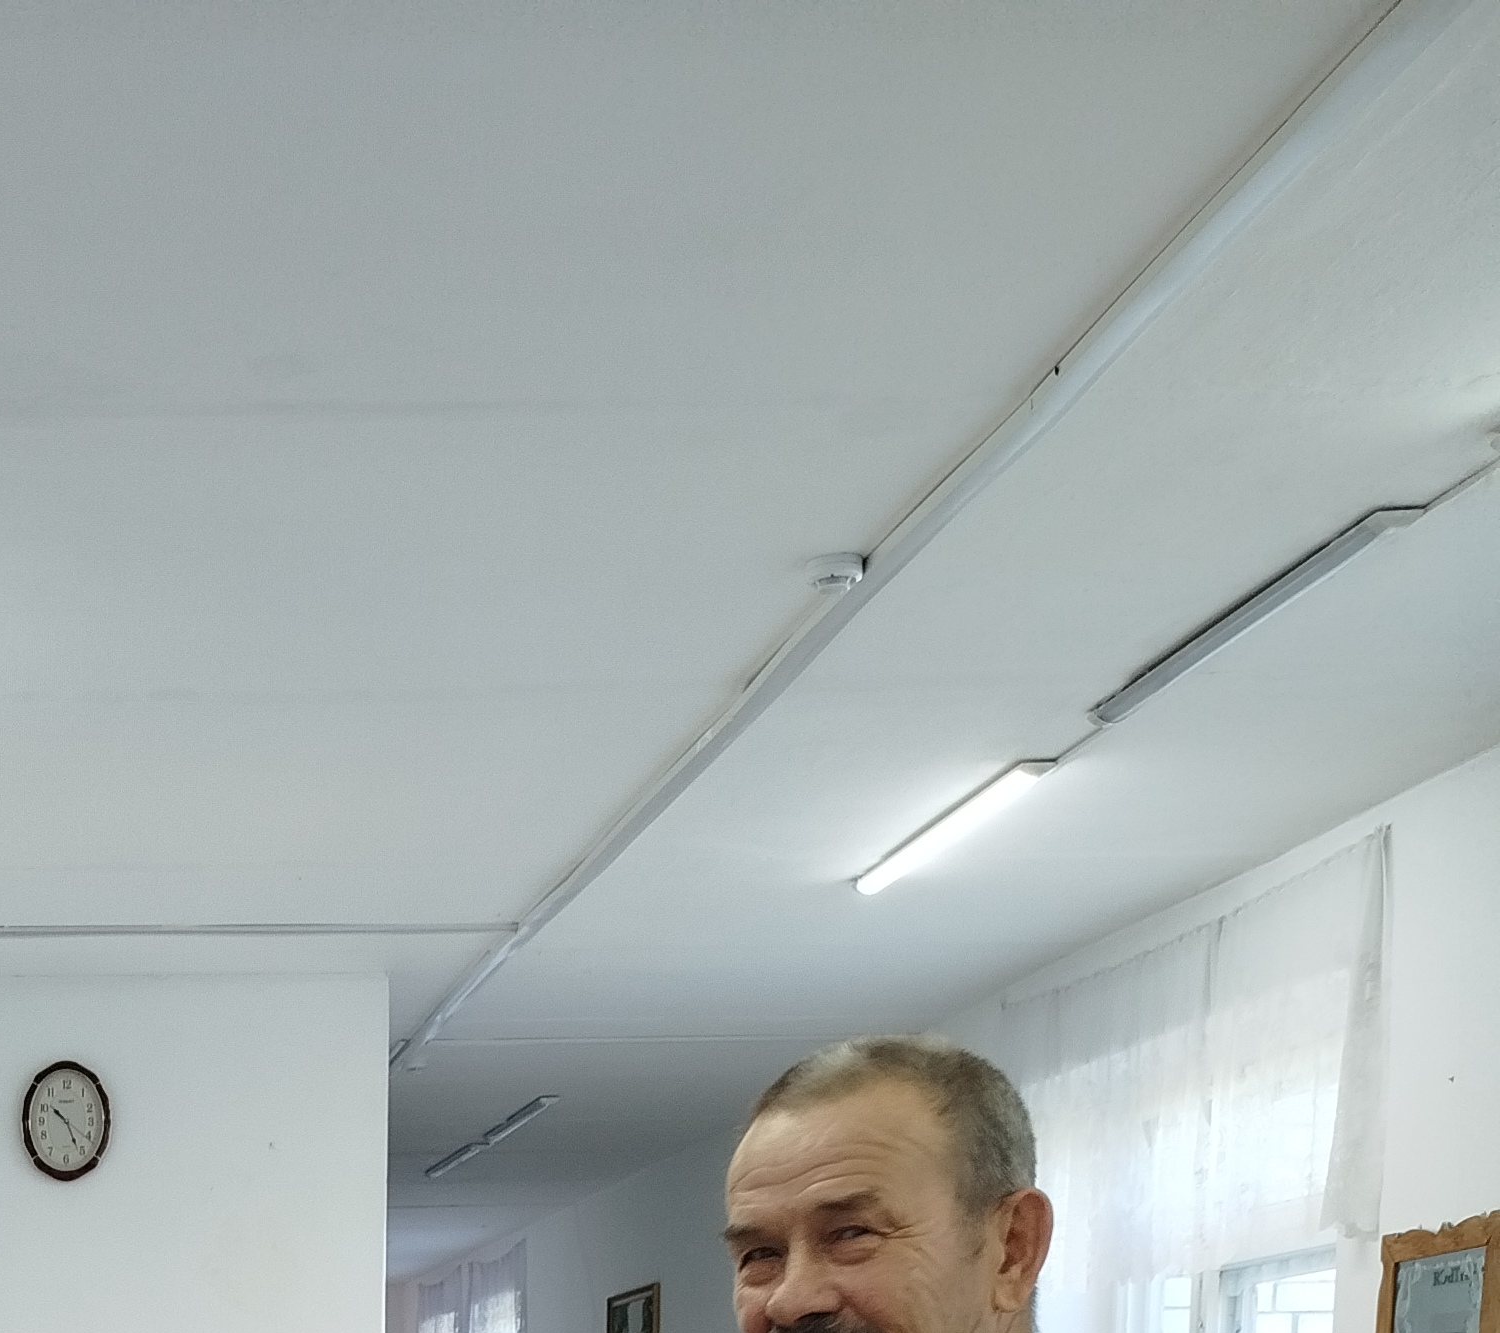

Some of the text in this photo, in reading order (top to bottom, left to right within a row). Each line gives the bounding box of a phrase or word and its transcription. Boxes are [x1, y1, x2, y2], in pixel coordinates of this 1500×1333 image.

[62, 1080, 72, 1090] 12
[47, 1087, 54, 1098] 11
[81, 1087, 85, 1098] 1
[40, 1103, 49, 1113] 10
[87, 1103, 93, 1113] 2
[38, 1116, 45, 1126] 9
[87, 1117, 94, 1127] 3
[41, 1130, 47, 1140] 8
[85, 1131, 92, 1141] 4
[47, 1146, 54, 1157] 7
[79, 1146, 85, 1156] 5
[62, 1154, 70, 1164] 6
